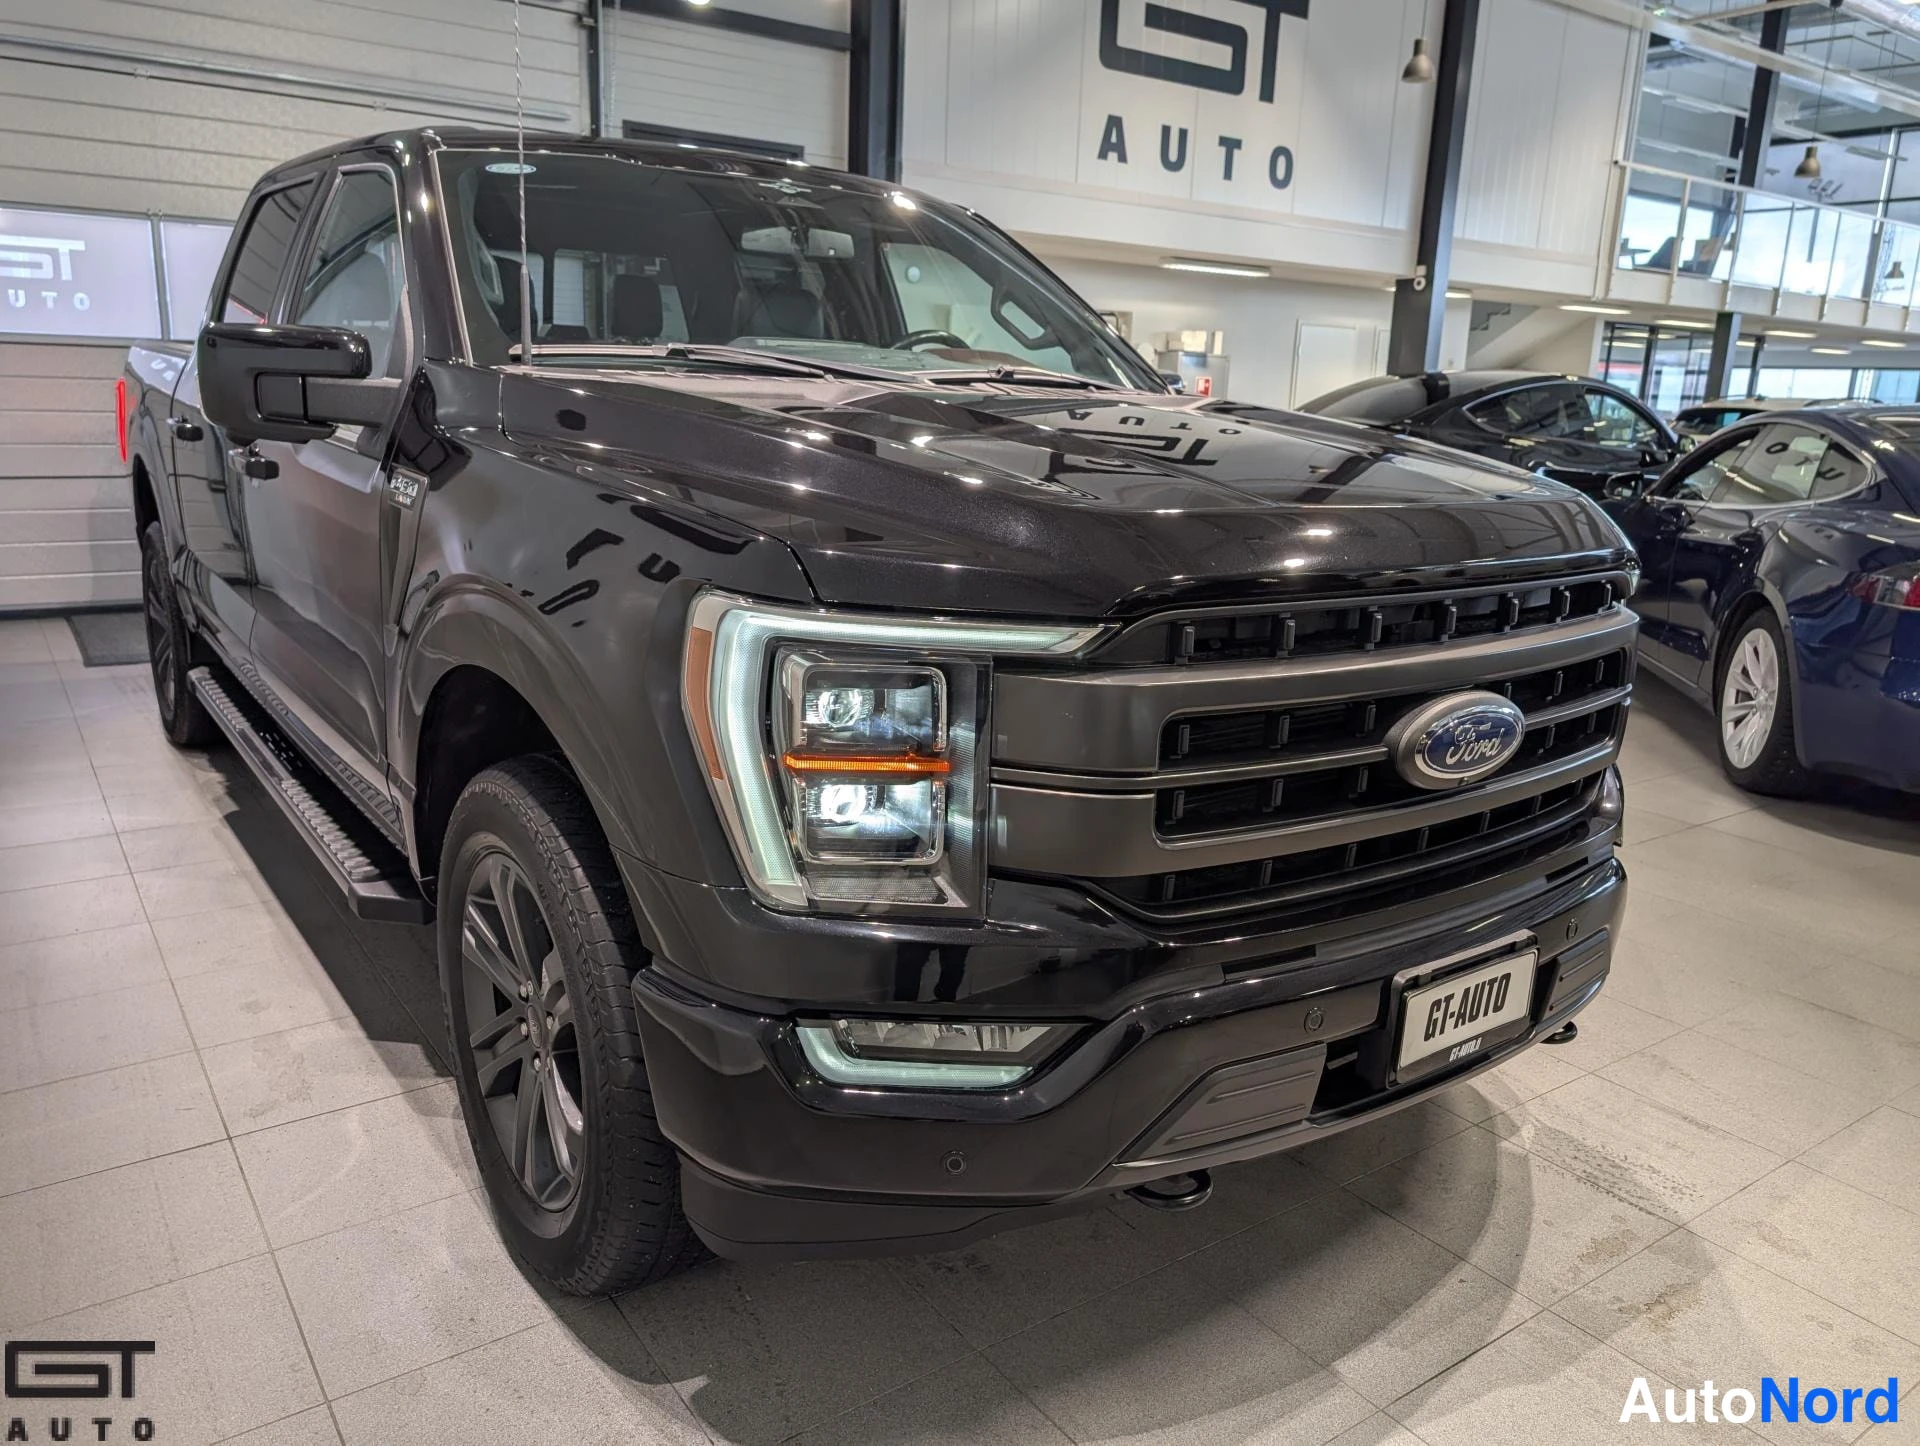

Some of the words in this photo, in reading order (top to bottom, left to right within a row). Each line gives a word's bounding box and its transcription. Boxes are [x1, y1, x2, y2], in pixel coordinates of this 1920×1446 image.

[1099, 0, 1309, 104] GT
[1097, 114, 1294, 190] AUTO
[8, 288, 91, 311] UTO
[1445, 721, 1506, 765] Ford
[1423, 972, 1512, 1042] GT-AUTO
